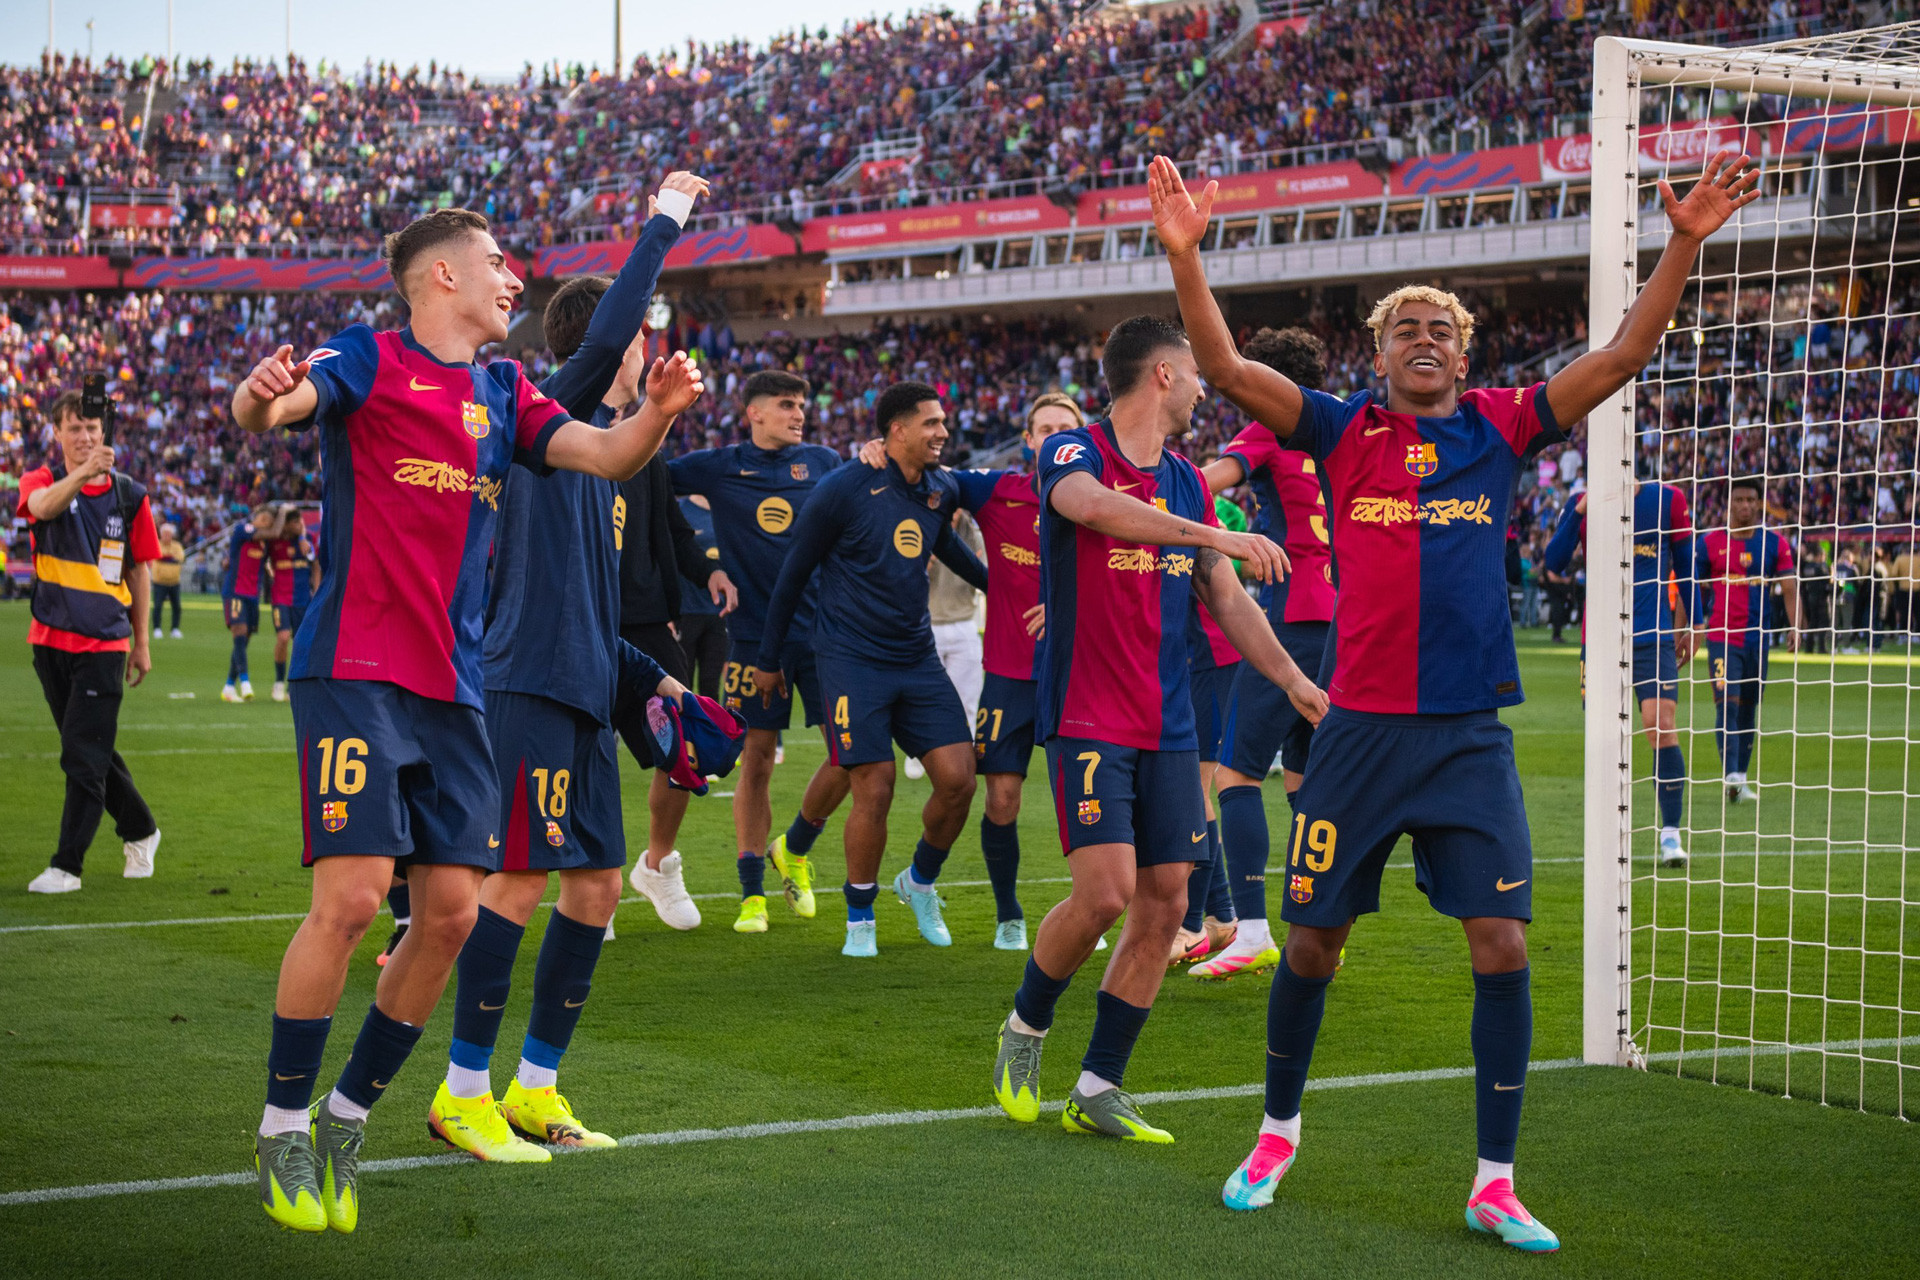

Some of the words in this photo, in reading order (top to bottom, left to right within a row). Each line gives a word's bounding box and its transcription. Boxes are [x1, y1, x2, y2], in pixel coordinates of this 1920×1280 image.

[724, 661, 758, 697] 35
[834, 695, 850, 729] 4
[976, 707, 1003, 742] 21
[317, 737, 369, 795] 16
[1076, 751, 1101, 795] 7
[532, 768, 570, 818] 18
[1291, 812, 1337, 873] 19
